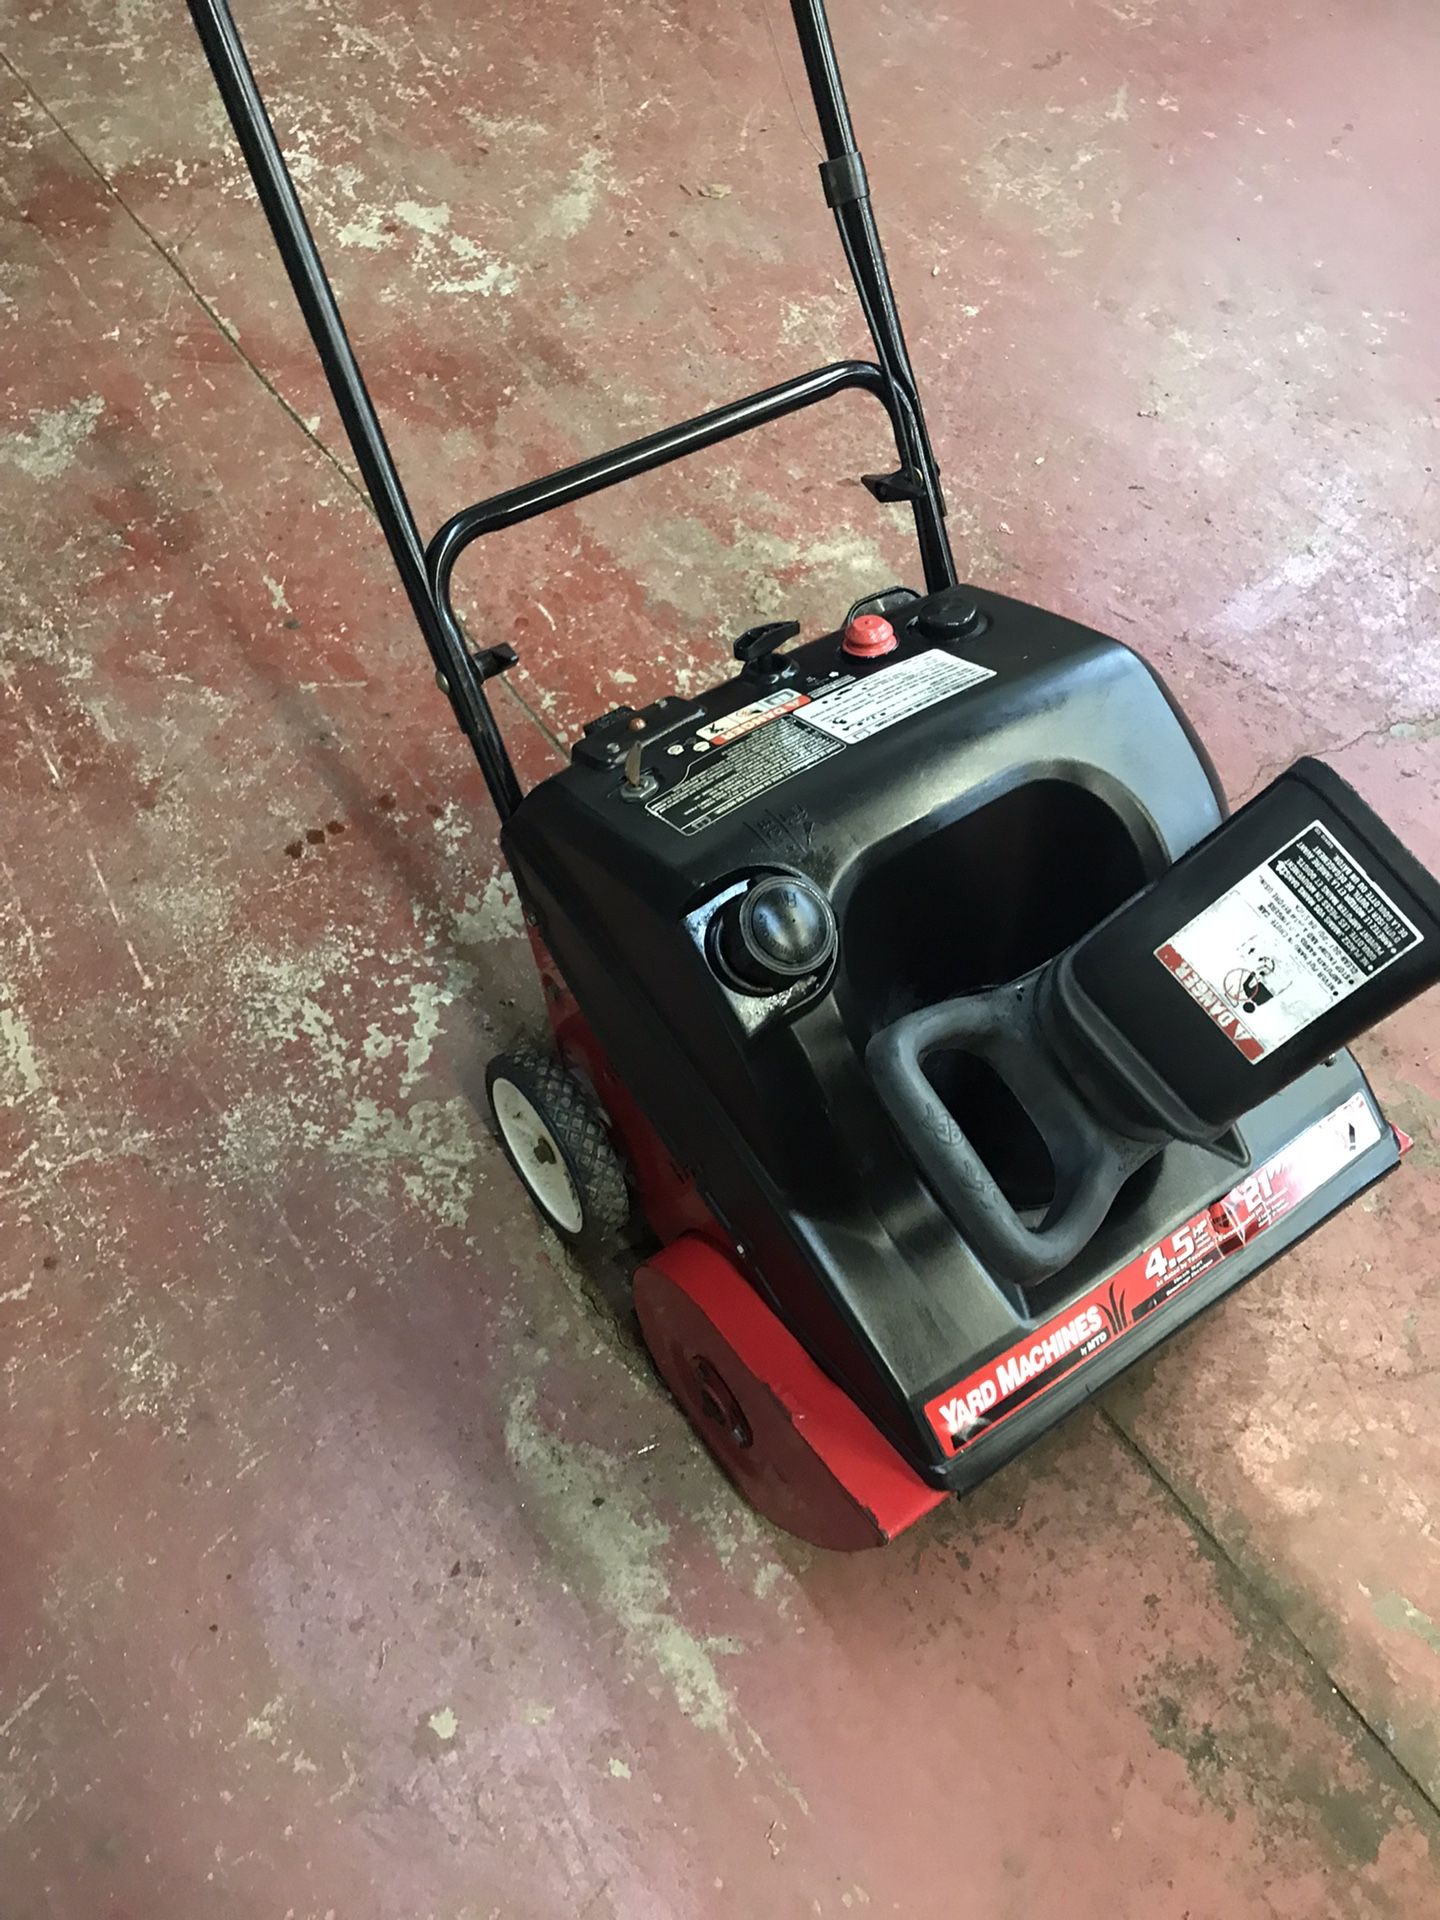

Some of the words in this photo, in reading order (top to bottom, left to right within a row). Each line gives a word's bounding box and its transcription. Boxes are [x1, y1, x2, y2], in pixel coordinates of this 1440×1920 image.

[719, 706, 787, 740] DANGER
[1295, 840, 1315, 860] AVANT
[1283, 857, 1317, 893] MOUVEMENT
[1313, 877, 1324, 887] ET
[1330, 878, 1340, 888] LA
[1349, 872, 1360, 884] UN
[1296, 885, 1316, 906] MAINS
[1313, 890, 1324, 901] EN
[1320, 884, 1340, 905] MAINS
[1336, 885, 1347, 896] ET
[1344, 880, 1355, 891] DE
[1356, 881, 1368, 893] OU
[1312, 903, 1327, 918] VOS
[1342, 893, 1367, 918] MOTEUR
[1364, 890, 1394, 921] GOULOTTE
[1322, 915, 1344, 938] JAMAIS
[1335, 902, 1363, 931] AMPUTER
[1337, 917, 1351, 931] LES
[1362, 915, 1373, 925] LE
[1370, 910, 1402, 943] D'UTILISER
[1390, 918, 1401, 929] LA
[1359, 928, 1385, 956] PEUVENT
[1397, 926, 1409, 938] DE
[1340, 935, 1363, 958] PLACEZ
[1358, 955, 1370, 967] NE
[1316, 971, 1336, 991] NEVER
[1334, 963, 1351, 980] STOP
[1172, 960, 1236, 1027] DANGER
[1144, 1226, 1195, 1281] 4.5
[1192, 1218, 1207, 1238] HP
[1086, 1330, 1107, 1352] MTD
[939, 1378, 999, 1436] YARD
[994, 1304, 1102, 1397] MACHINES
